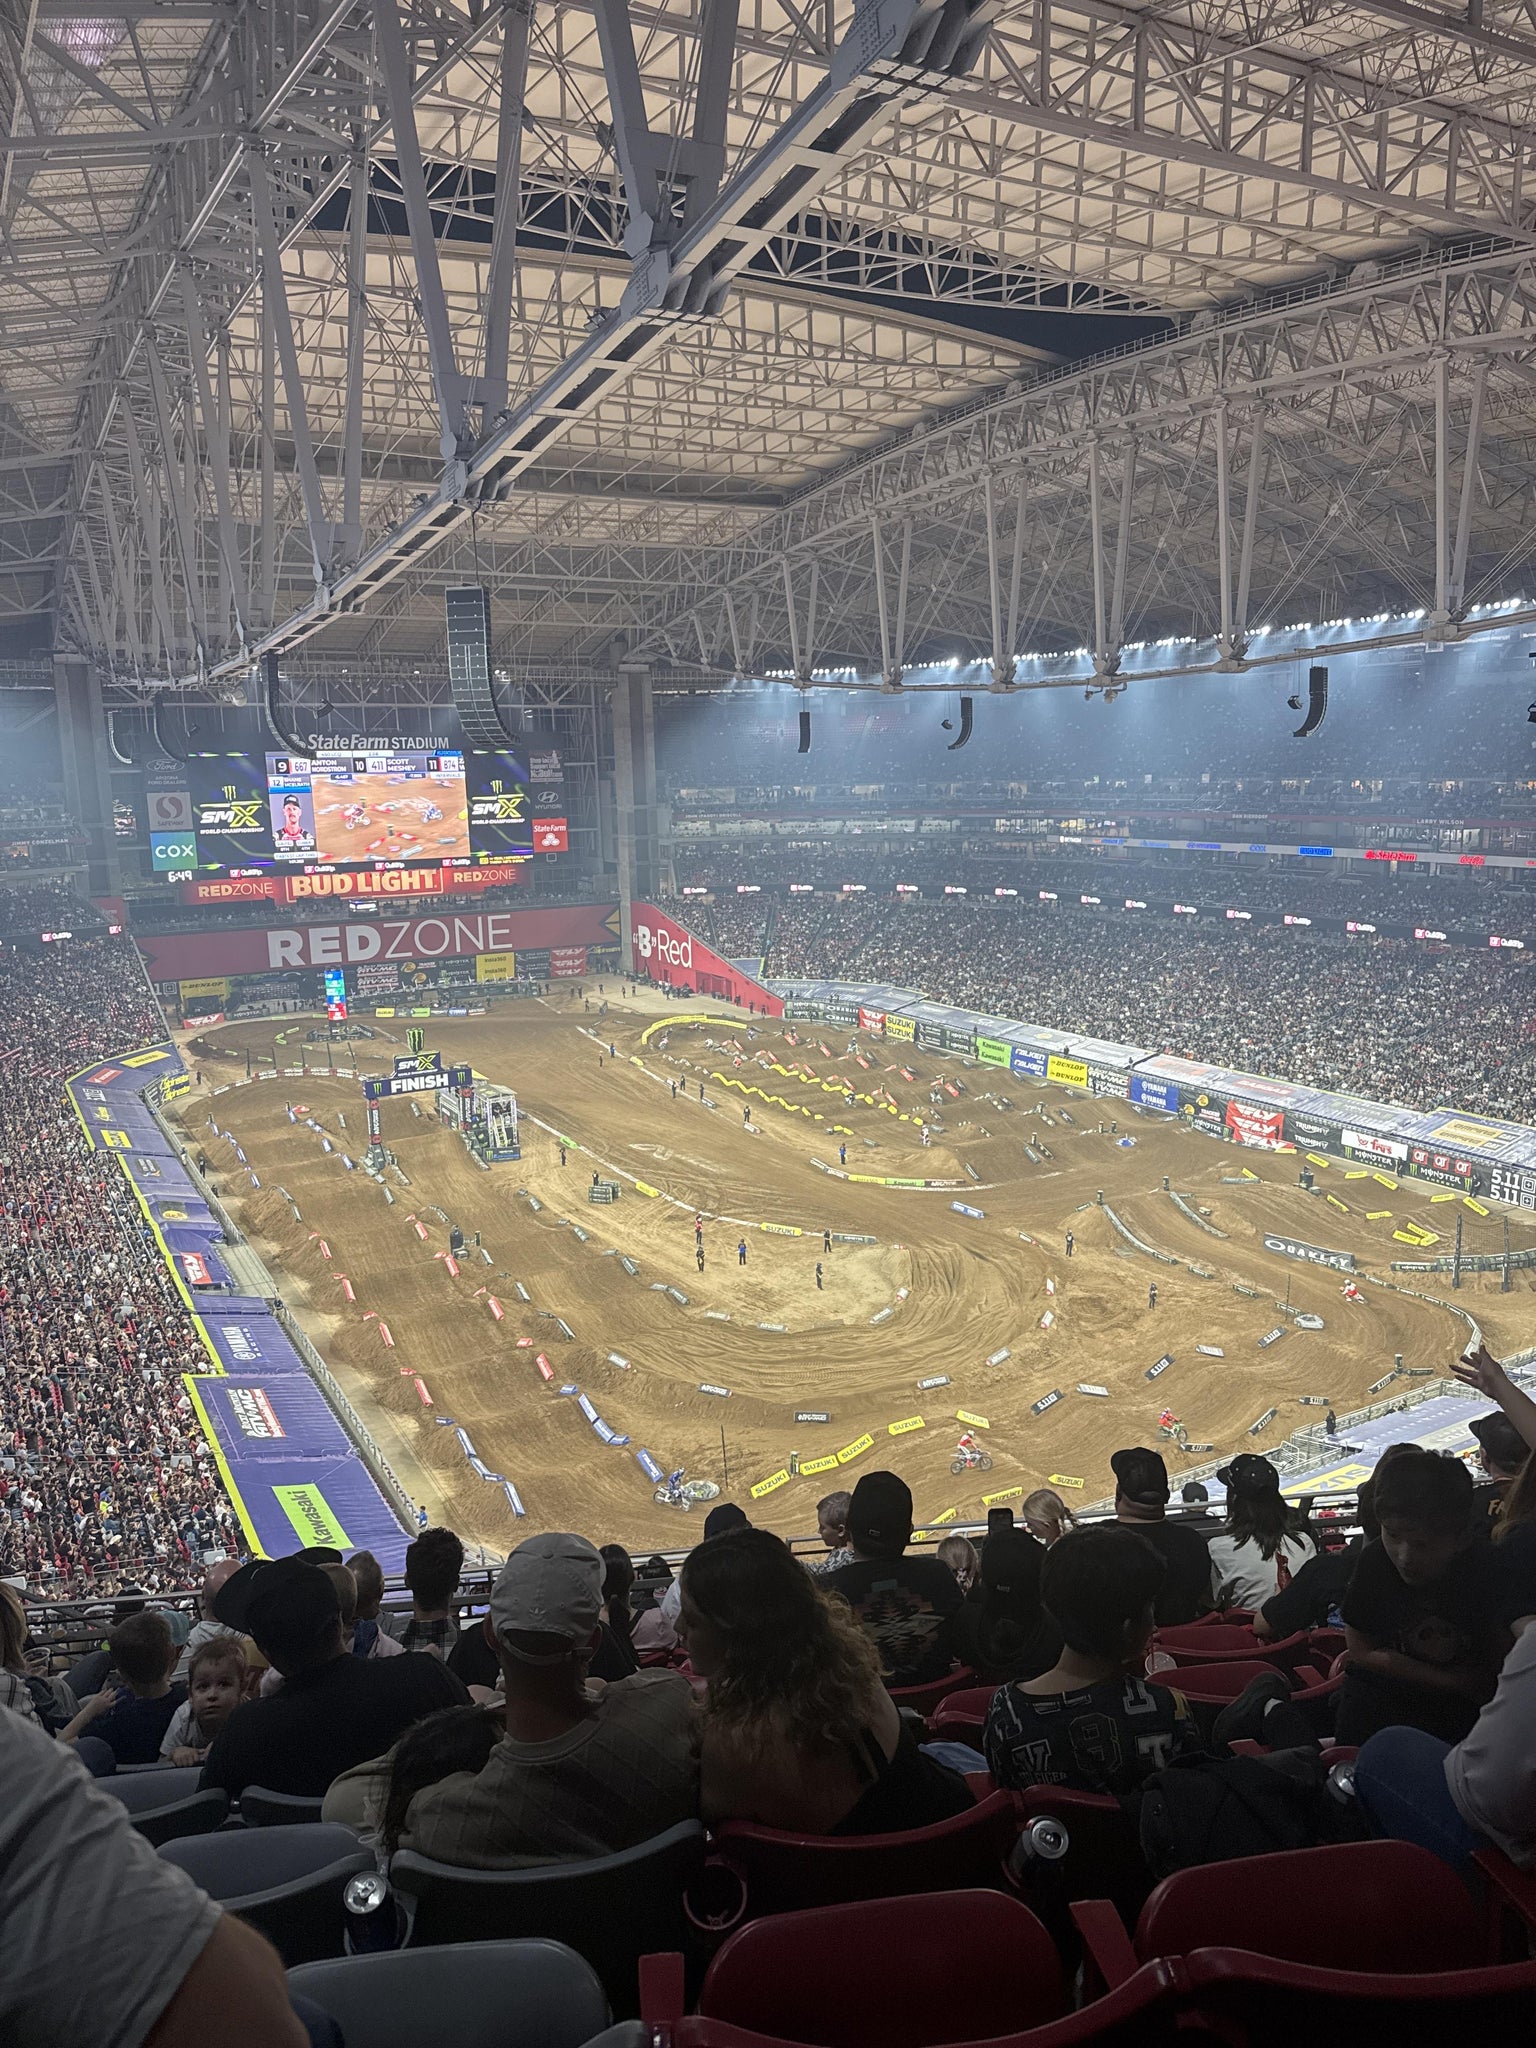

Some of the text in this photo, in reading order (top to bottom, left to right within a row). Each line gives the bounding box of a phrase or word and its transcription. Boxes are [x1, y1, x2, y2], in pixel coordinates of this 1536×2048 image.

[391, 737, 449, 749] STADIUM
[153, 761, 177, 770] Ford
[277, 761, 287, 772] 9
[294, 761, 308, 772] 667
[354, 761, 365, 771] 10
[371, 761, 384, 771] 411
[428, 760, 437, 770] 11
[472, 798, 523, 818] SMX
[200, 806, 261, 827] SMX
[155, 844, 194, 858] COX
[1249, 844, 1266, 852] COX
[168, 870, 193, 883] 6:49
[291, 873, 354, 897] BUD
[657, 928, 693, 969] Red
[188, 981, 224, 989] DUNLOP
[887, 1015, 914, 1029] SUZUKI
[886, 1025, 914, 1038] SUZUKI
[982, 1040, 1005, 1052] Kawasaki
[981, 1051, 1005, 1063] Kawasaki
[1015, 1048, 1046, 1061] FALKEN
[398, 1054, 436, 1071] SMX
[1014, 1059, 1044, 1072] FALKEN
[1055, 1060, 1085, 1071] DUNLOP
[390, 1073, 449, 1093] FINISH
[1055, 1072, 1085, 1083] DUNLOP
[1194, 1118, 1222, 1134] MONSTER
[1295, 1121, 1326, 1134] TRIUMPH
[1294, 1135, 1325, 1148] TRIUMPH
[1354, 1149, 1393, 1166] MONSTER
[1413, 1151, 1470, 1174] QT QT QT
[1420, 1167, 1461, 1185] MONSTER
[1491, 1168, 1521, 1189] 5.11
[1489, 1183, 1520, 1206] 5.11
[766, 1226, 796, 1236] SUZUKI
[1287, 1245, 1350, 1267] OAKLEY
[242, 1327, 262, 1358] RACING
[892, 1418, 922, 1432] SUZUKI
[962, 1411, 988, 1426] SUZUKI
[841, 1437, 871, 1459] SUZUKI
[803, 1458, 836, 1472] SUZUKI
[755, 1473, 786, 1494] SUZUKI
[1056, 1476, 1082, 1486] SUZUKI
[990, 1487, 1021, 1503] SUZUKI
[287, 1490, 337, 1545] Kawasaki
